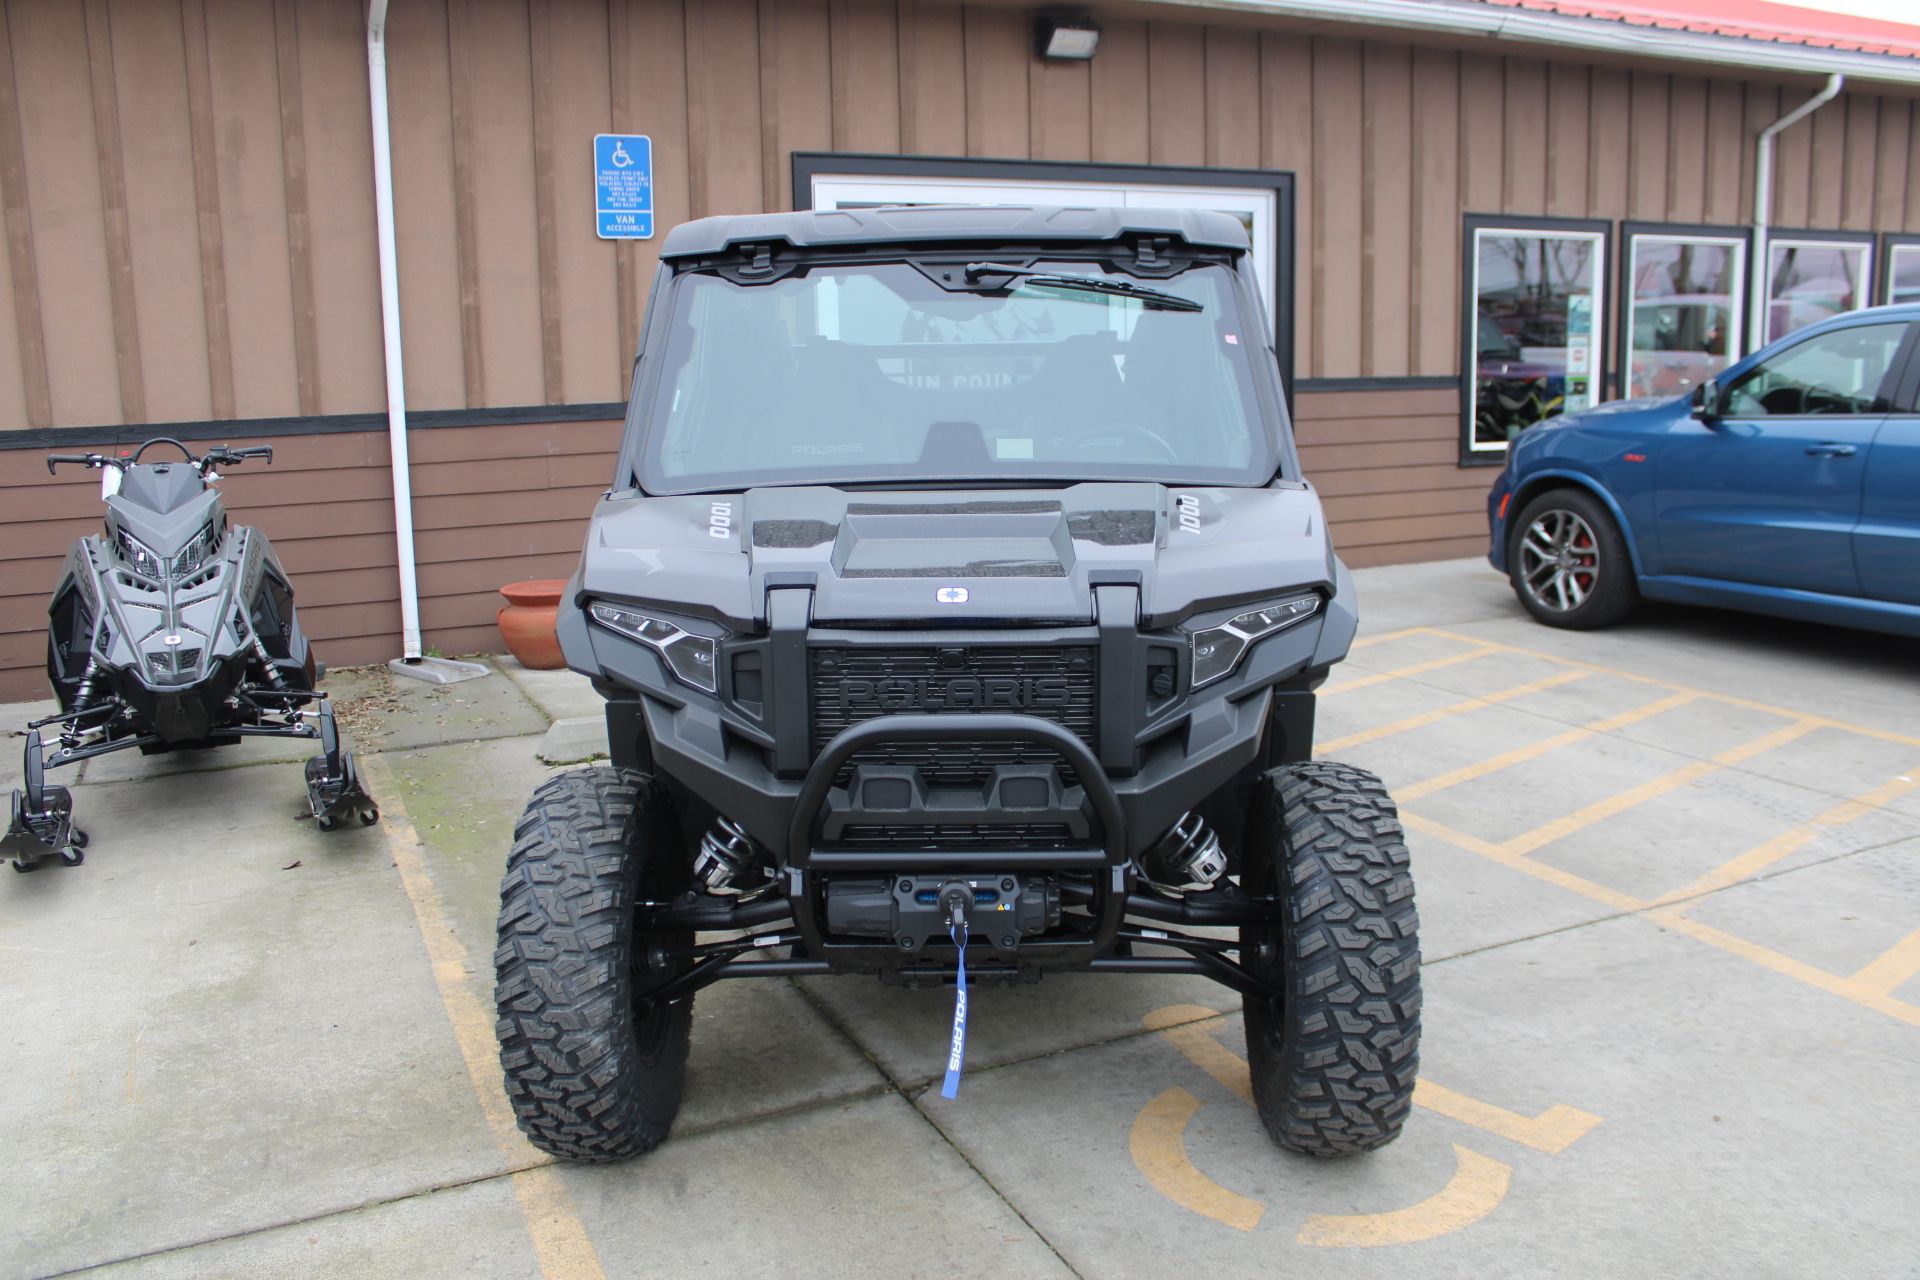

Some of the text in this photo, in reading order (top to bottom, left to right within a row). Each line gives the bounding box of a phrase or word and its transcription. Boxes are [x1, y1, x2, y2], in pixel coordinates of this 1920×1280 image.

[606, 224, 645, 232] ACCESSIBLE
[616, 215, 635, 224] VAN
[791, 443, 864, 455] POLARIS
[710, 502, 731, 539] 1000
[1179, 495, 1200, 534] 1000
[75, 550, 97, 611] POLARIS
[243, 539, 261, 600] POLARIS
[839, 679, 1071, 707] POLARIS
[949, 990, 965, 1072] POLARIS
